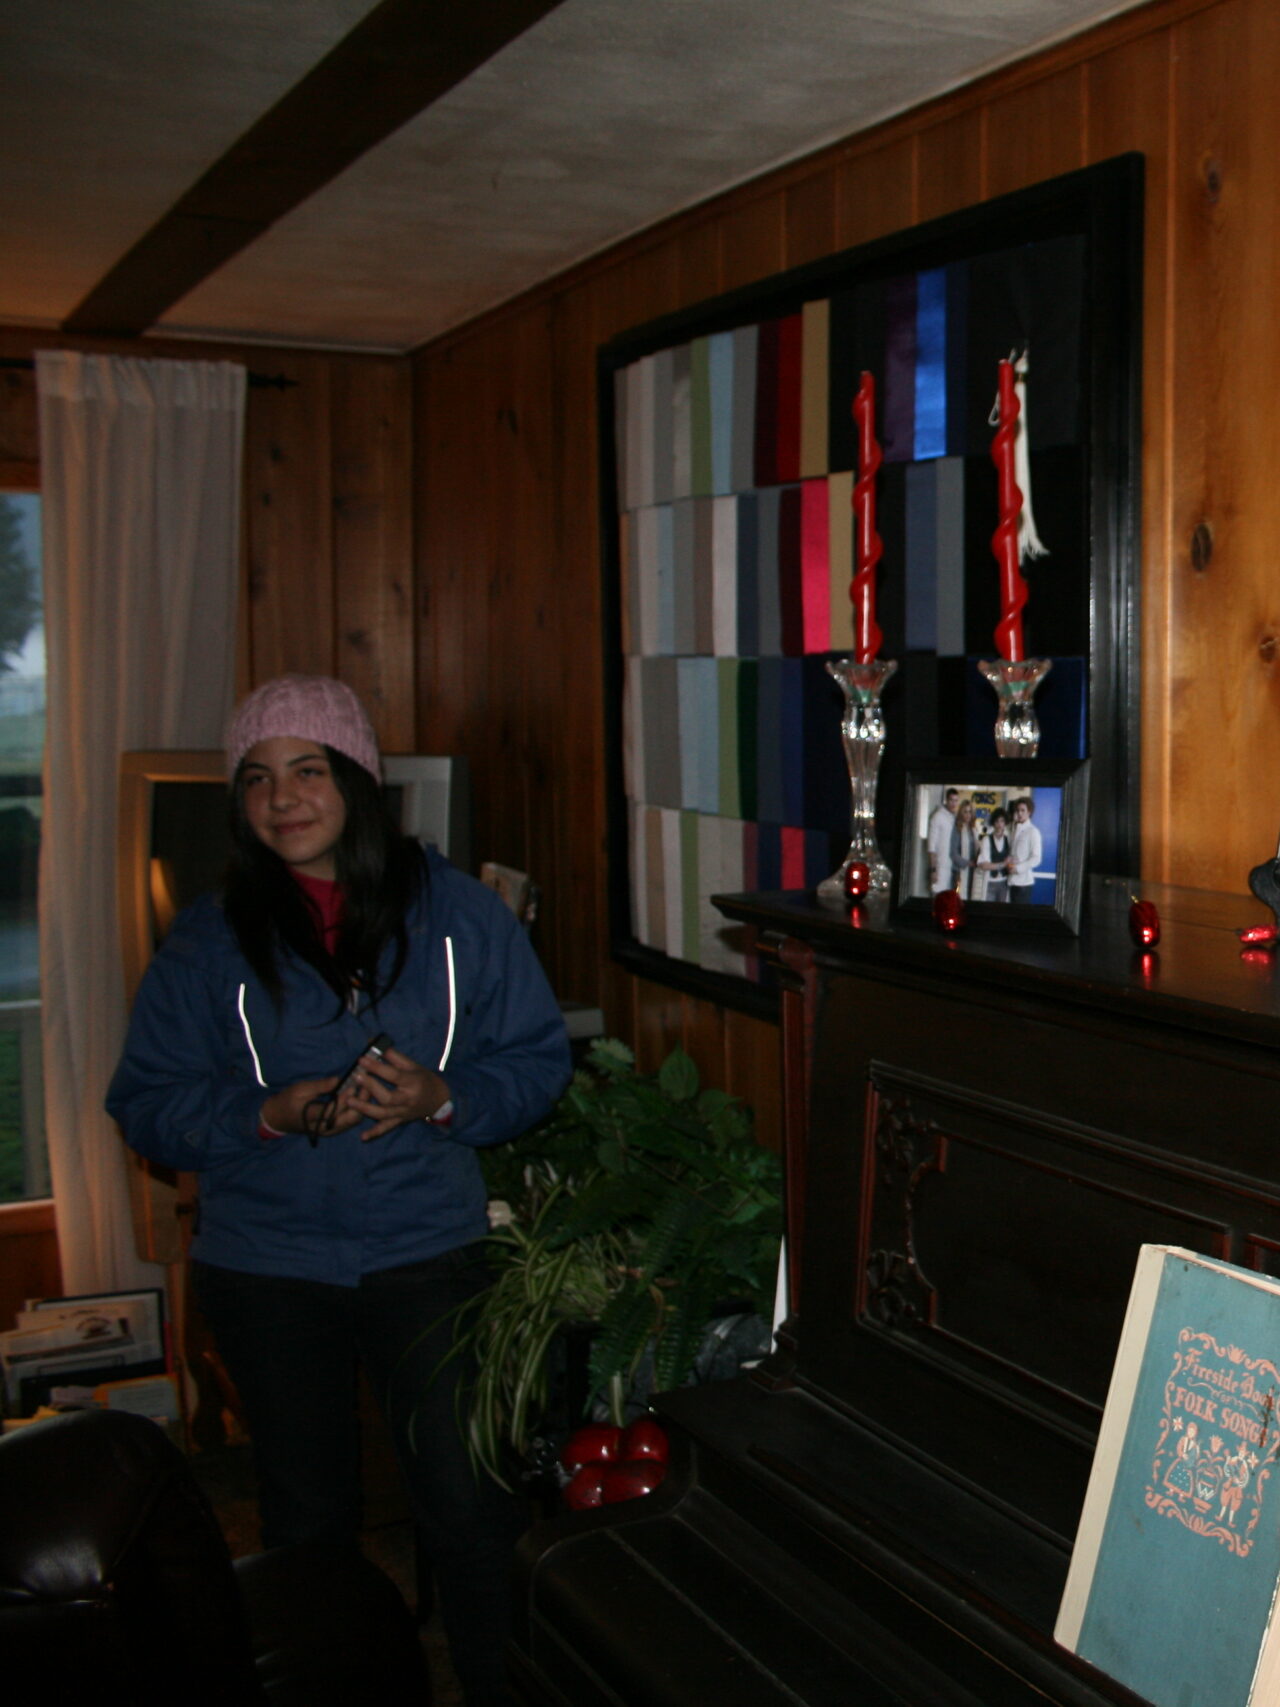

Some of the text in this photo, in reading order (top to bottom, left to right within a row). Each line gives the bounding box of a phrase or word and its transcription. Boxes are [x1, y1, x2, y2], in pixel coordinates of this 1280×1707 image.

[1183, 1348, 1275, 1412] Fireside Book
[1173, 1386, 1269, 1448] FOLK SONGS
